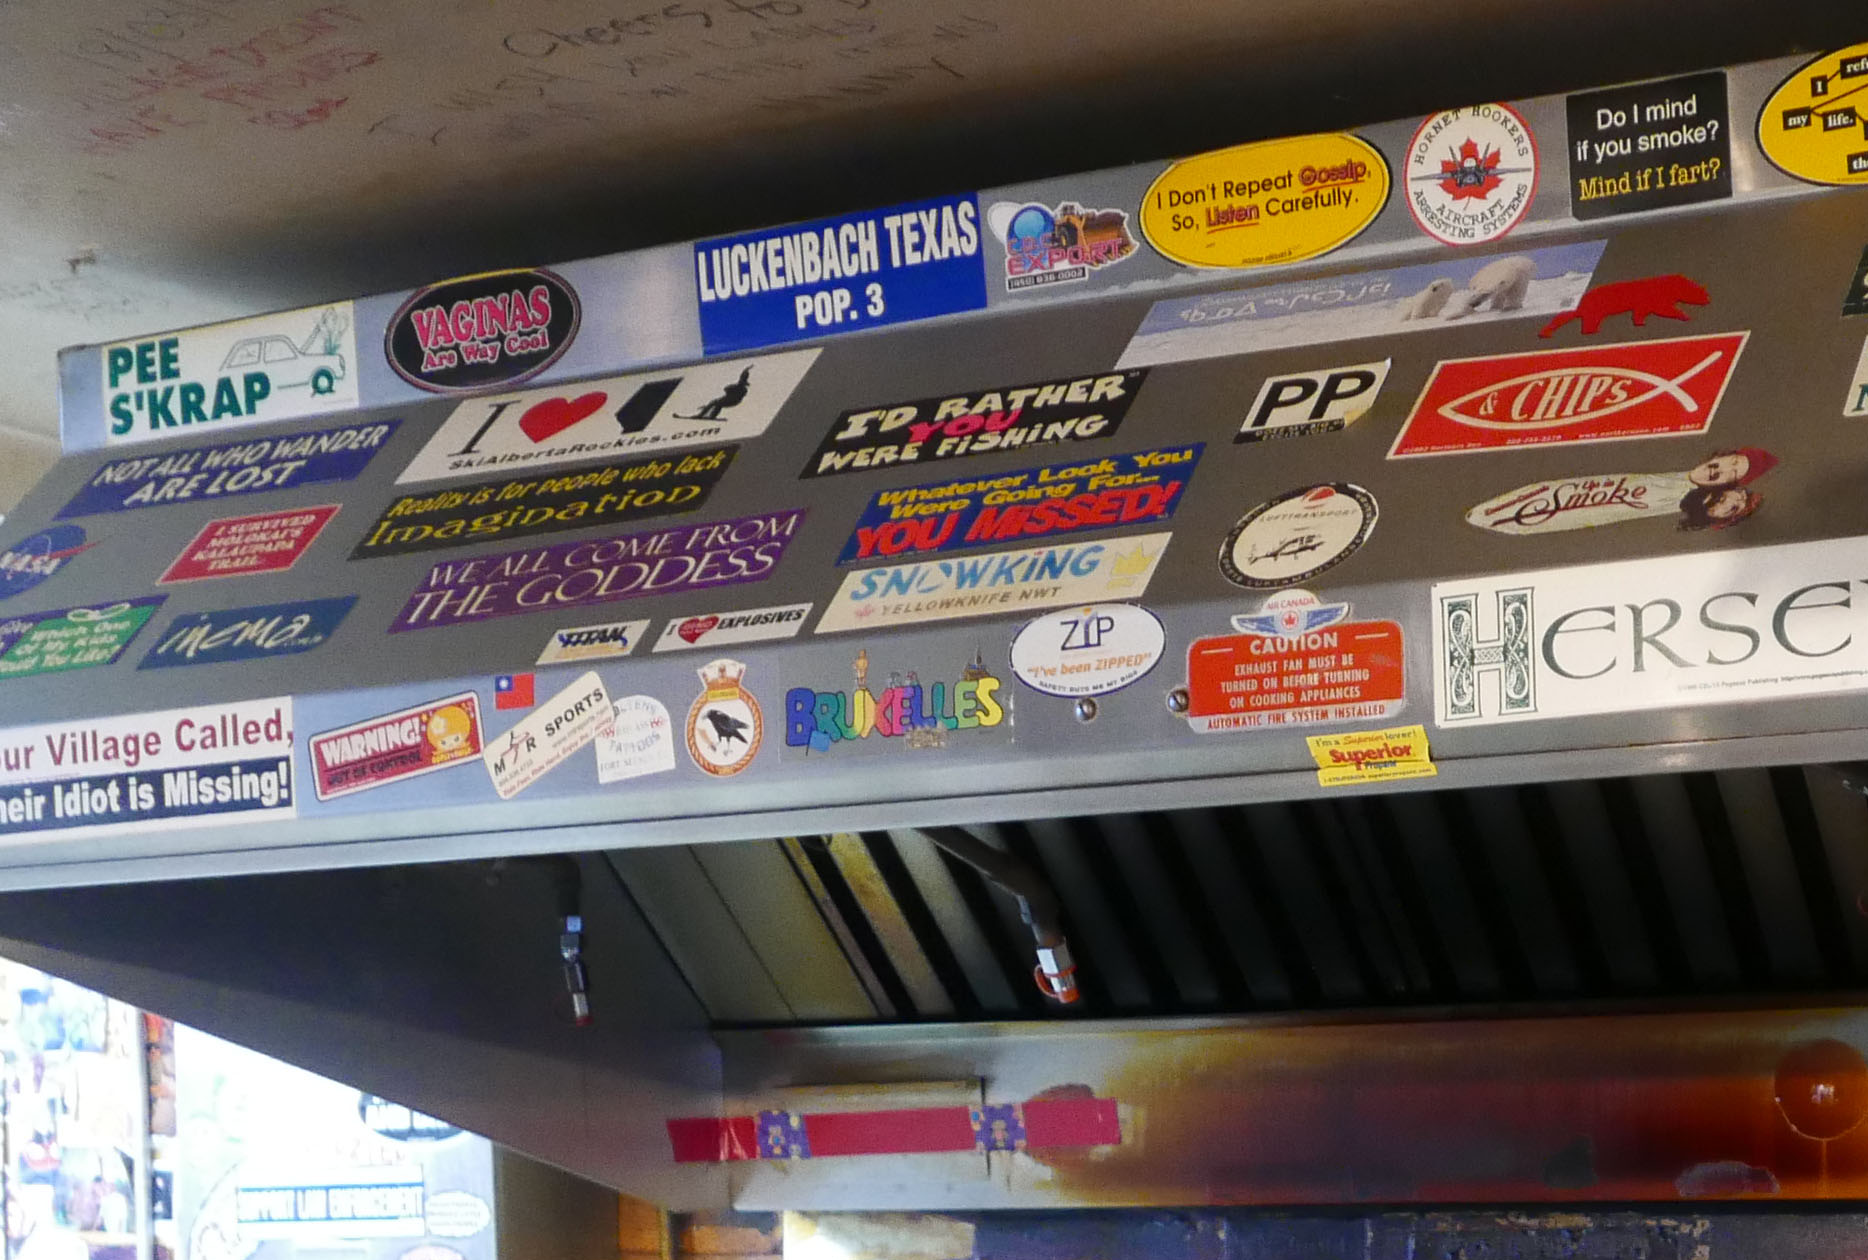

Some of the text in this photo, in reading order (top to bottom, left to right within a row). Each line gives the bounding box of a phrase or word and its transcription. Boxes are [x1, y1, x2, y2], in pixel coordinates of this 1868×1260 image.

[1597, 95, 1697, 130] Do mind
[1788, 114, 1809, 128] my
[1577, 121, 1719, 163] if you smoke?
[1168, 171, 1294, 206] Don't Repeat
[1579, 158, 1721, 200] Mind if fart?
[1206, 187, 1359, 226] Listen Carefully.
[698, 202, 978, 302] LUCKENBACH TEXAS
[411, 286, 551, 347] VAGINAS
[795, 284, 885, 328] POP. 3
[108, 339, 179, 388] PEE
[423, 331, 548, 371] Are Way Cool
[109, 371, 271, 436] S'KRAP
[934, 374, 1125, 419] RATHER
[908, 409, 1022, 444] YOU
[817, 440, 923, 473] WERE
[856, 513, 959, 559] YOU
[966, 480, 1180, 542] MISSED!
[430, 514, 798, 587] WE ALL COME FROM
[407, 542, 780, 623] THE GODDESS
[1235, 654, 1354, 676] EXHAUST FAN MUST BE
[1250, 633, 1338, 655] CAUTION
[1221, 669, 1369, 693] TURNED ON BEFORE TURNING
[1230, 686, 1360, 708] ON COOKING APPLIANCES
[786, 676, 1004, 748] BRUXELLES
[1207, 705, 1385, 730] AUTOMATIC FIRE SYSTEM INSTALLED
[45, 711, 294, 767] Village Called,
[53, 762, 289, 815] Idiot is Missing!
